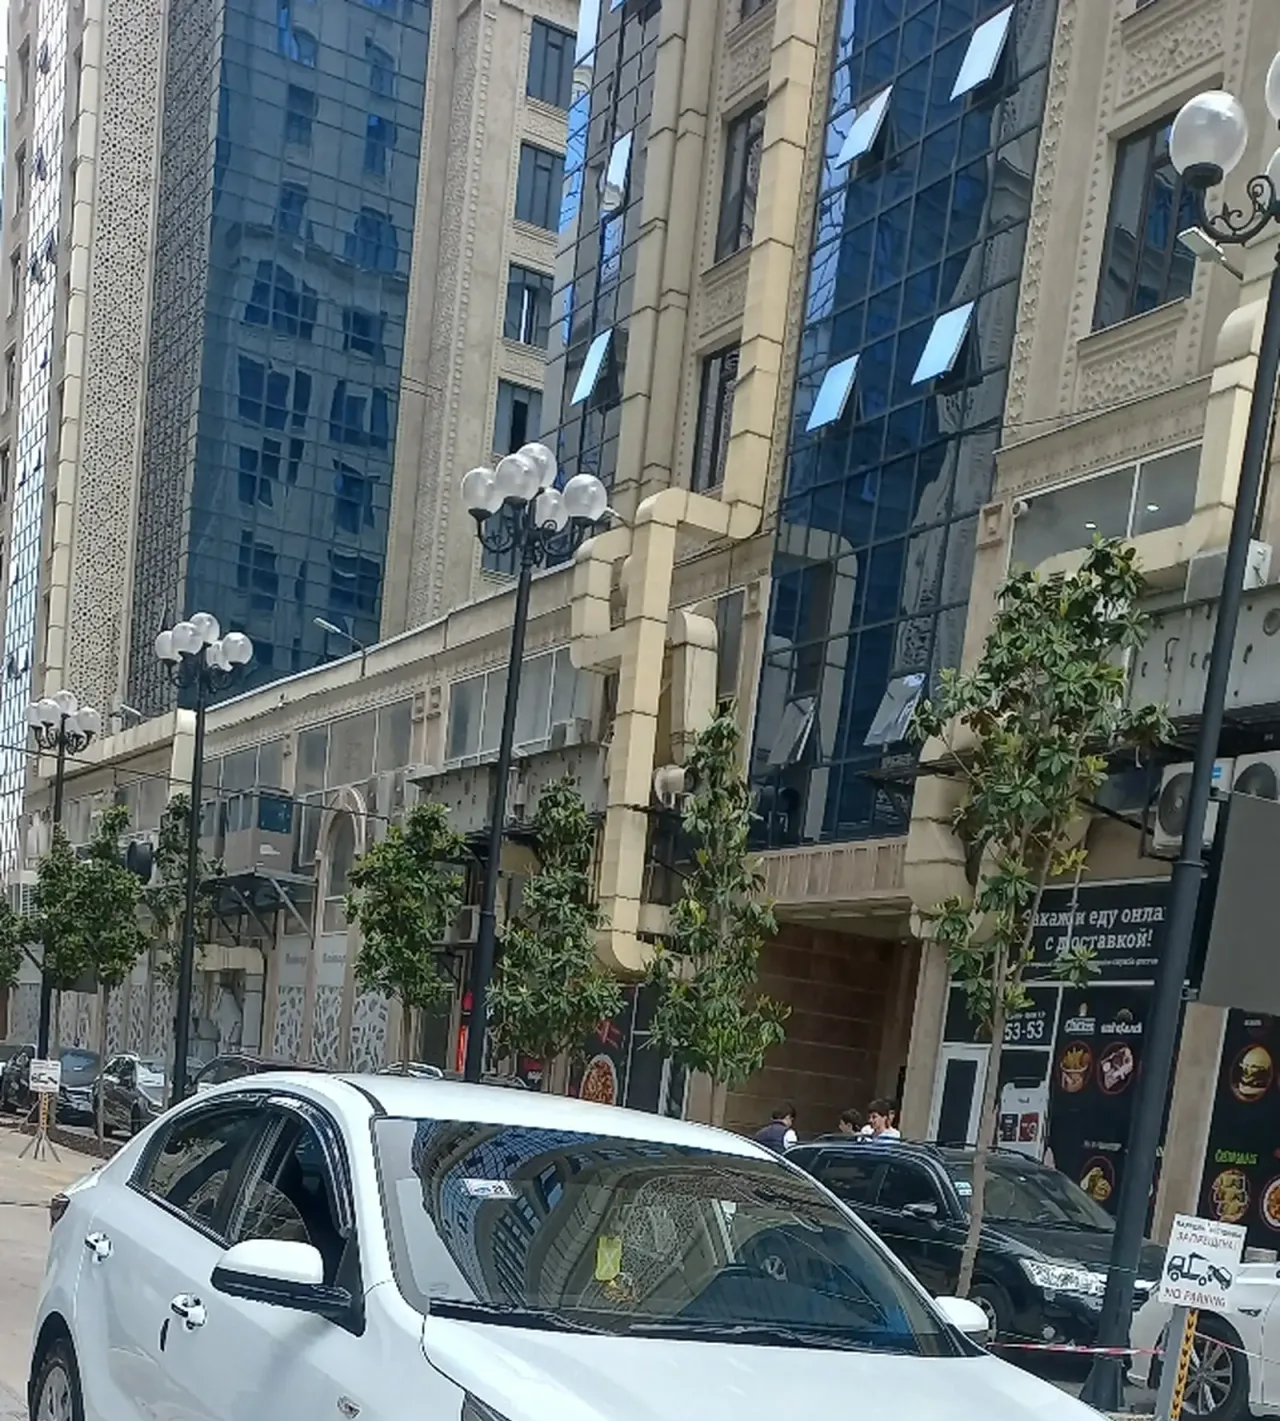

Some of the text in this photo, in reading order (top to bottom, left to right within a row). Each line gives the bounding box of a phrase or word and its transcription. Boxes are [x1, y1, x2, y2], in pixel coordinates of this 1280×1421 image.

[1089, 909, 1119, 929] еду
[1121, 906, 1167, 923] онла
[1045, 928, 1153, 953] с доставкой!
[1163, 1287, 1226, 1307] NO PARKING
